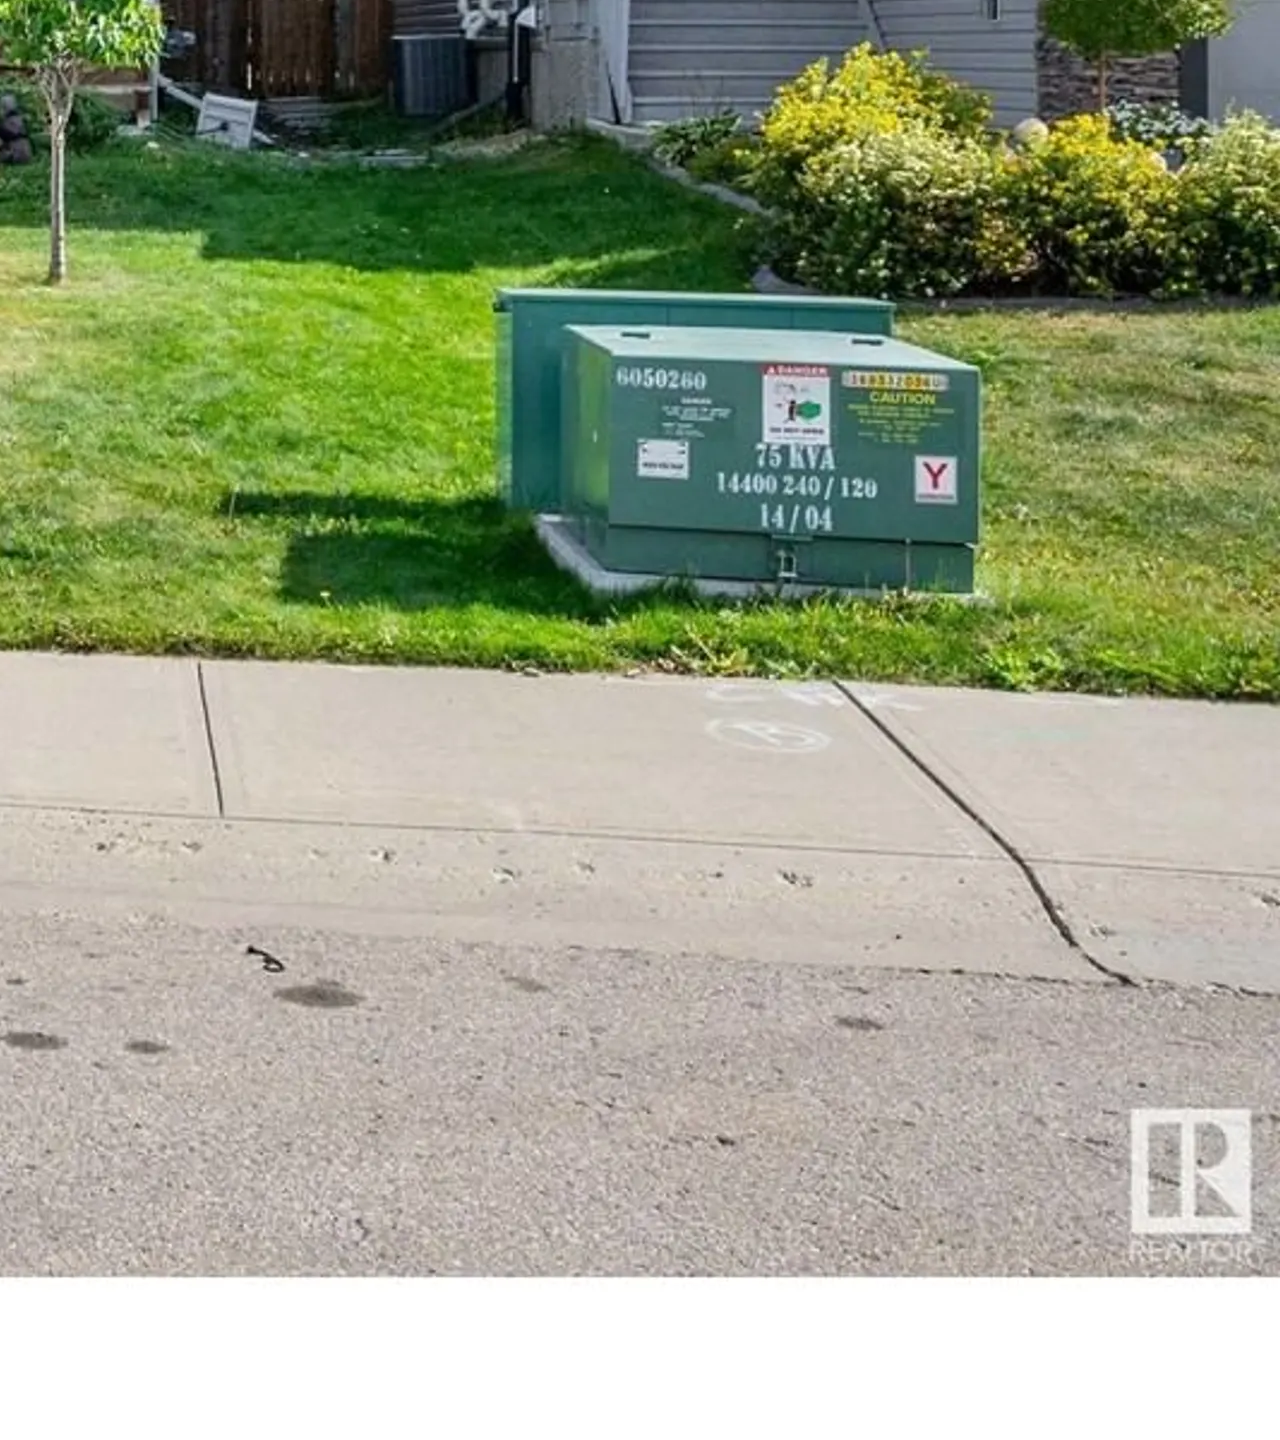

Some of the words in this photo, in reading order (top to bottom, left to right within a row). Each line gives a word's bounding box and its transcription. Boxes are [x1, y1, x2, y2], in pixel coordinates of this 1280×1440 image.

[616, 366, 707, 390] 6050260
[869, 391, 936, 405] CAUTION
[755, 444, 783, 468] 75
[789, 444, 836, 470] KVA
[717, 471, 778, 494] 14400
[783, 474, 821, 496] 240
[841, 477, 878, 499] 120
[922, 461, 948, 489] Y
[761, 503, 784, 529] 14
[805, 505, 833, 531] 04
